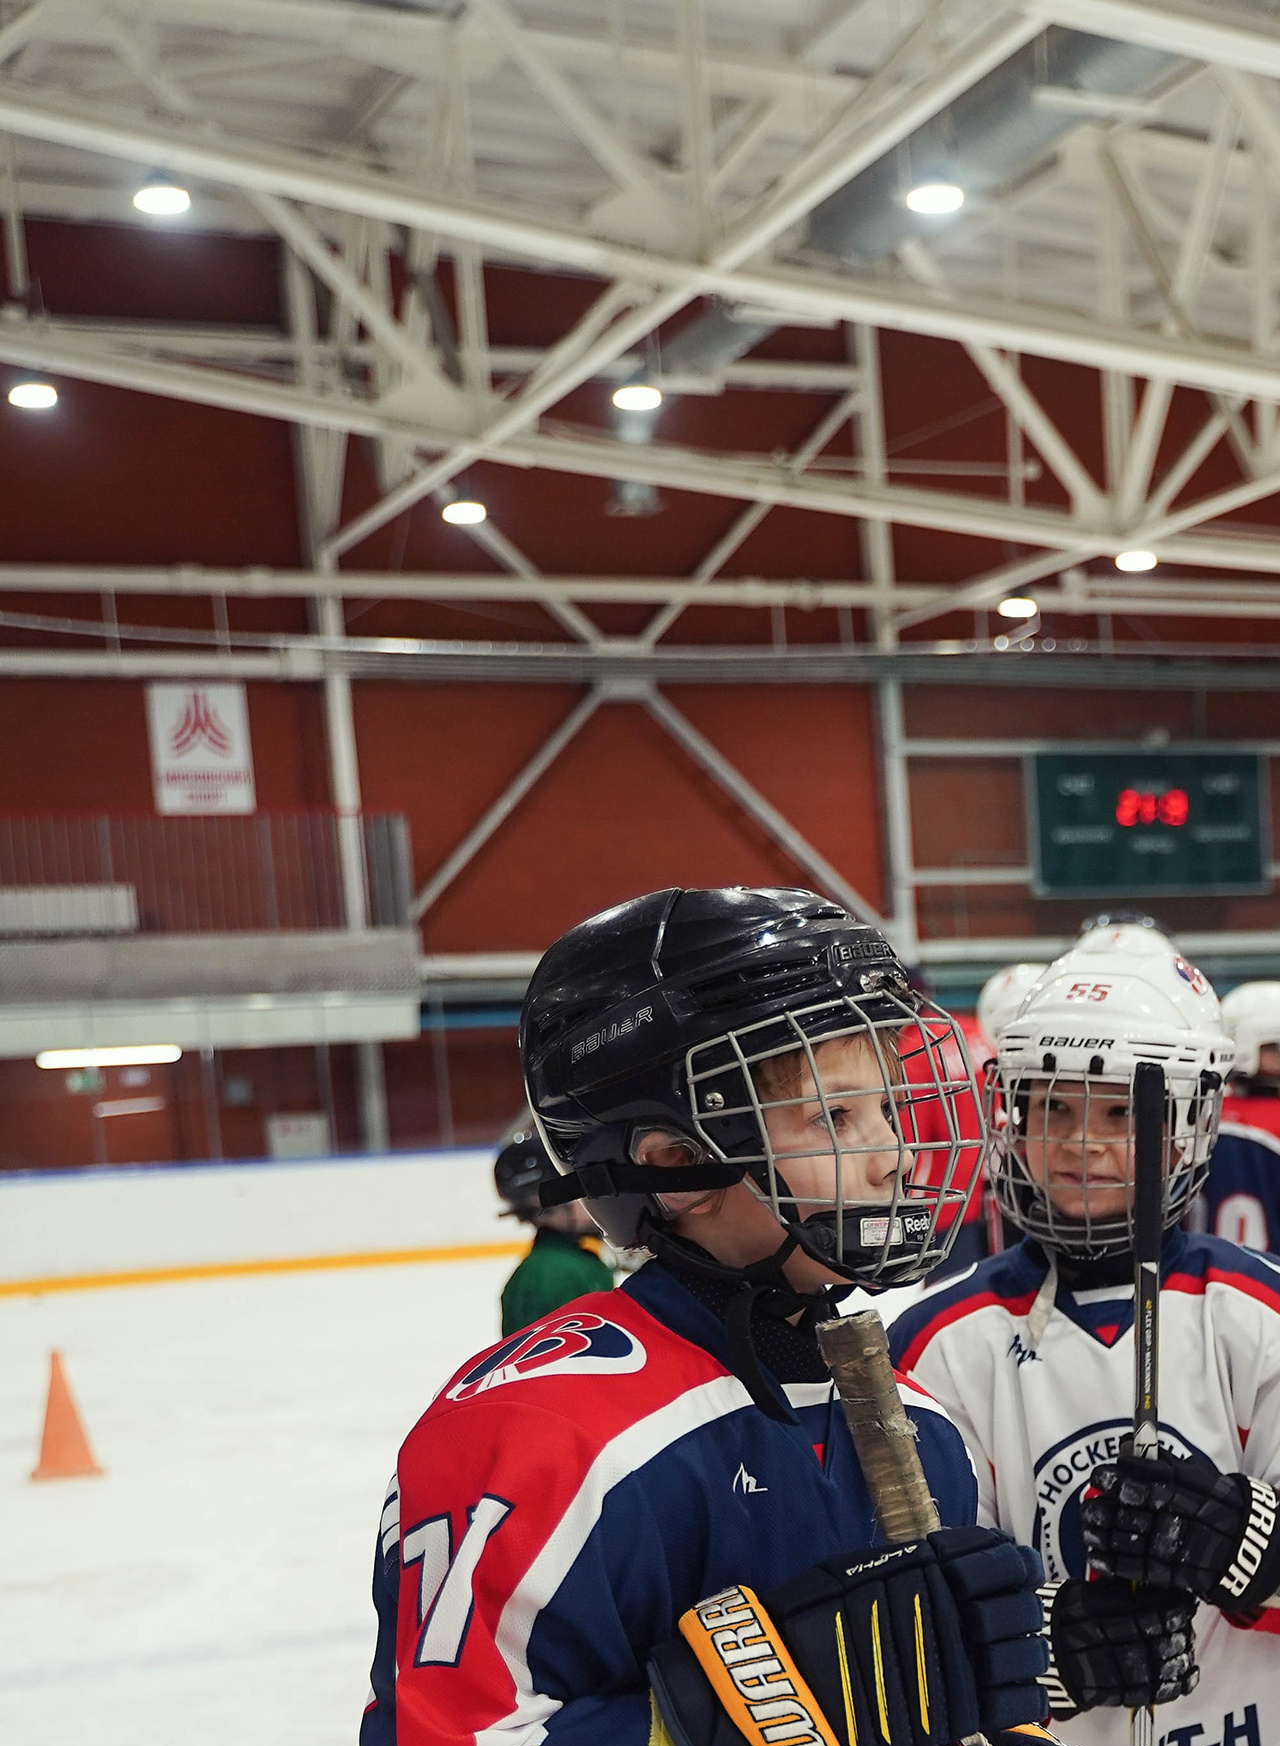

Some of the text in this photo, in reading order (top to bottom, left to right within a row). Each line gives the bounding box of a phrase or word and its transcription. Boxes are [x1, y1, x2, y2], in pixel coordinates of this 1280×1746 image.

[1066, 982, 1113, 1002] 55
[571, 1005, 654, 1064] BAUER
[1039, 1035, 1115, 1050] BAUER
[1039, 1437, 1119, 1505] HOCKE
[1219, 1476, 1279, 1597] RRIOR
